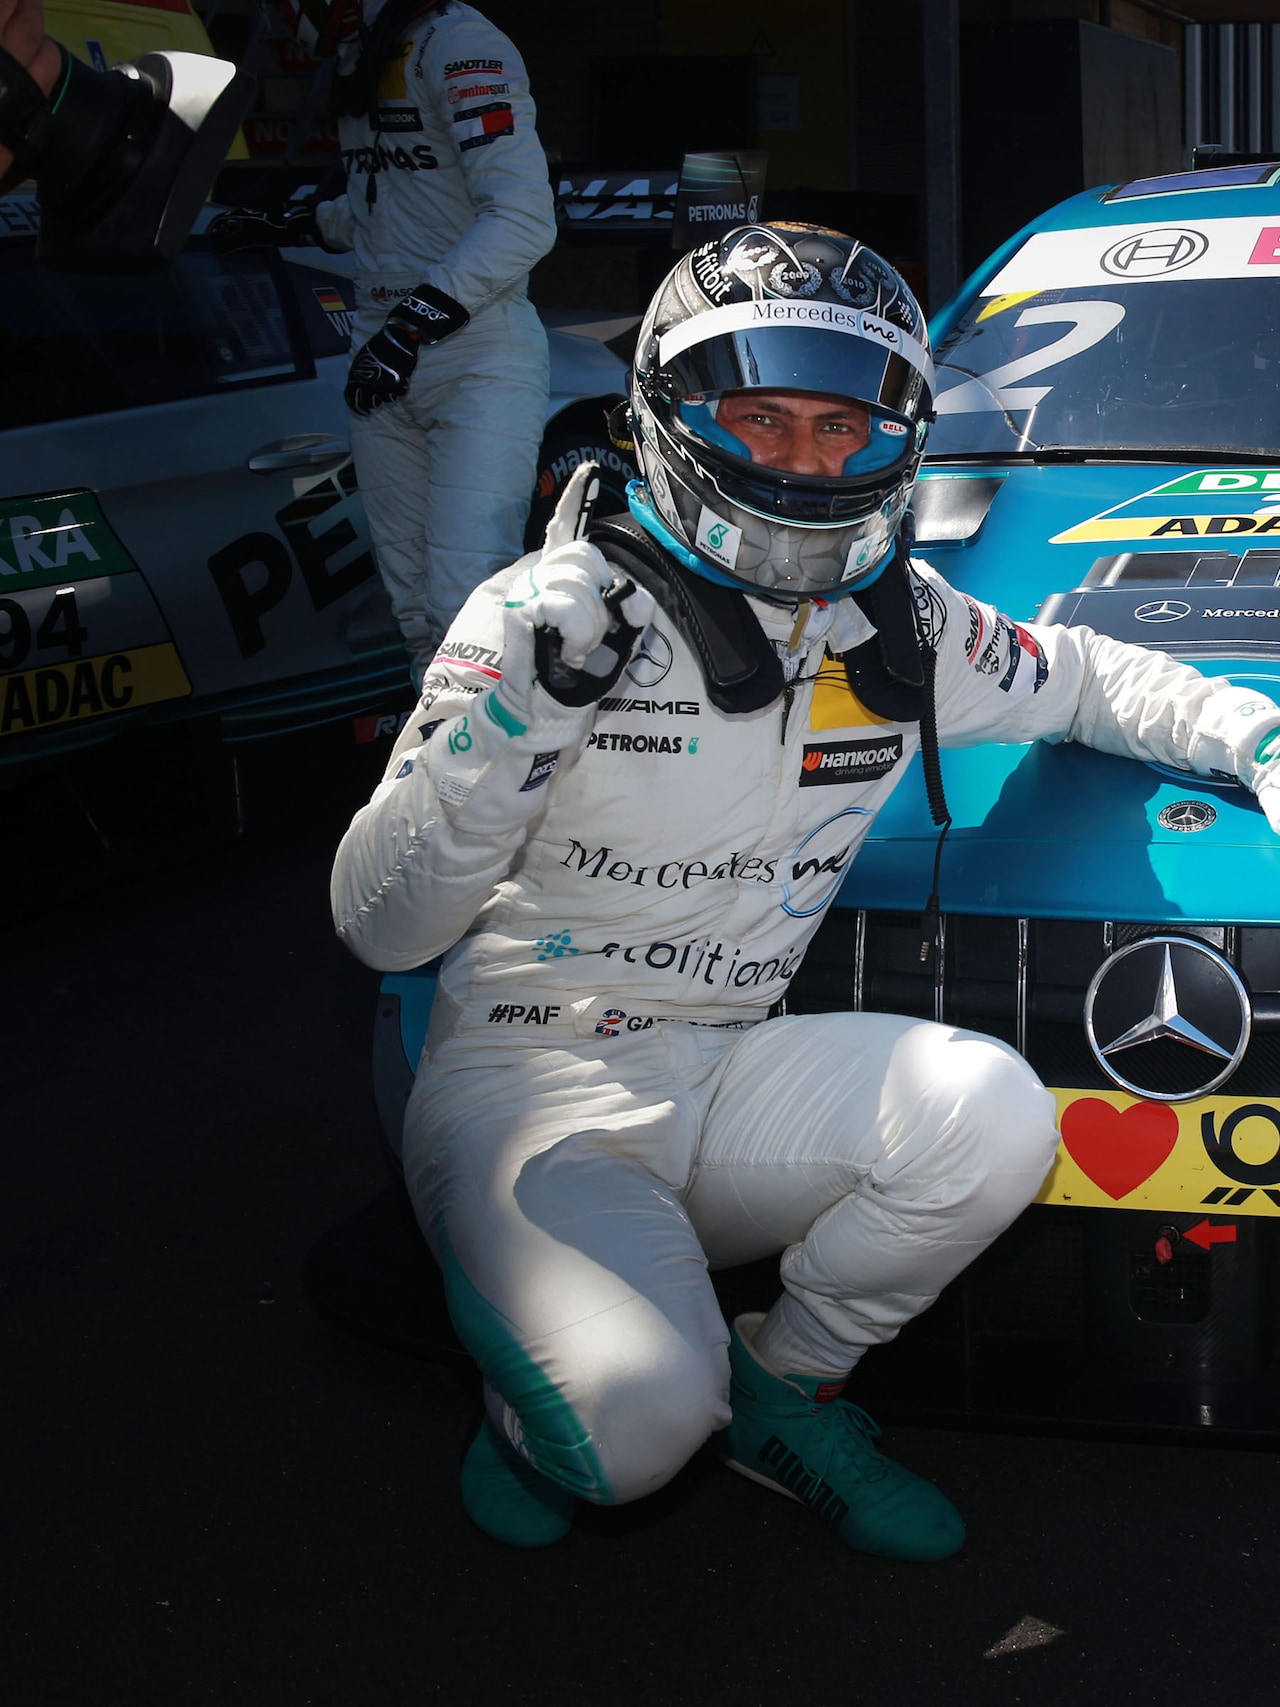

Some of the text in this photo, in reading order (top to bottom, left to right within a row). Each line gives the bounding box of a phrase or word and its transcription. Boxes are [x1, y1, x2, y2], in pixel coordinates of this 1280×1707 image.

[444, 60, 503, 75] SANDTLER
[688, 202, 746, 222] PETRONAS
[695, 252, 734, 302] fitbit
[388, 288, 413, 298] PASC
[752, 303, 898, 343] Mercedes me
[934, 301, 1125, 415] 2
[882, 421, 904, 433] BELL
[699, 541, 731, 565] PETRONAS
[0, 588, 88, 669] 94
[437, 642, 503, 669] SANDTL
[2, 656, 132, 732] ADAC
[629, 699, 700, 715] AMG
[587, 732, 682, 755] PETRONAS
[835, 765, 864, 776] driving
[488, 1003, 561, 1025] #PAF
